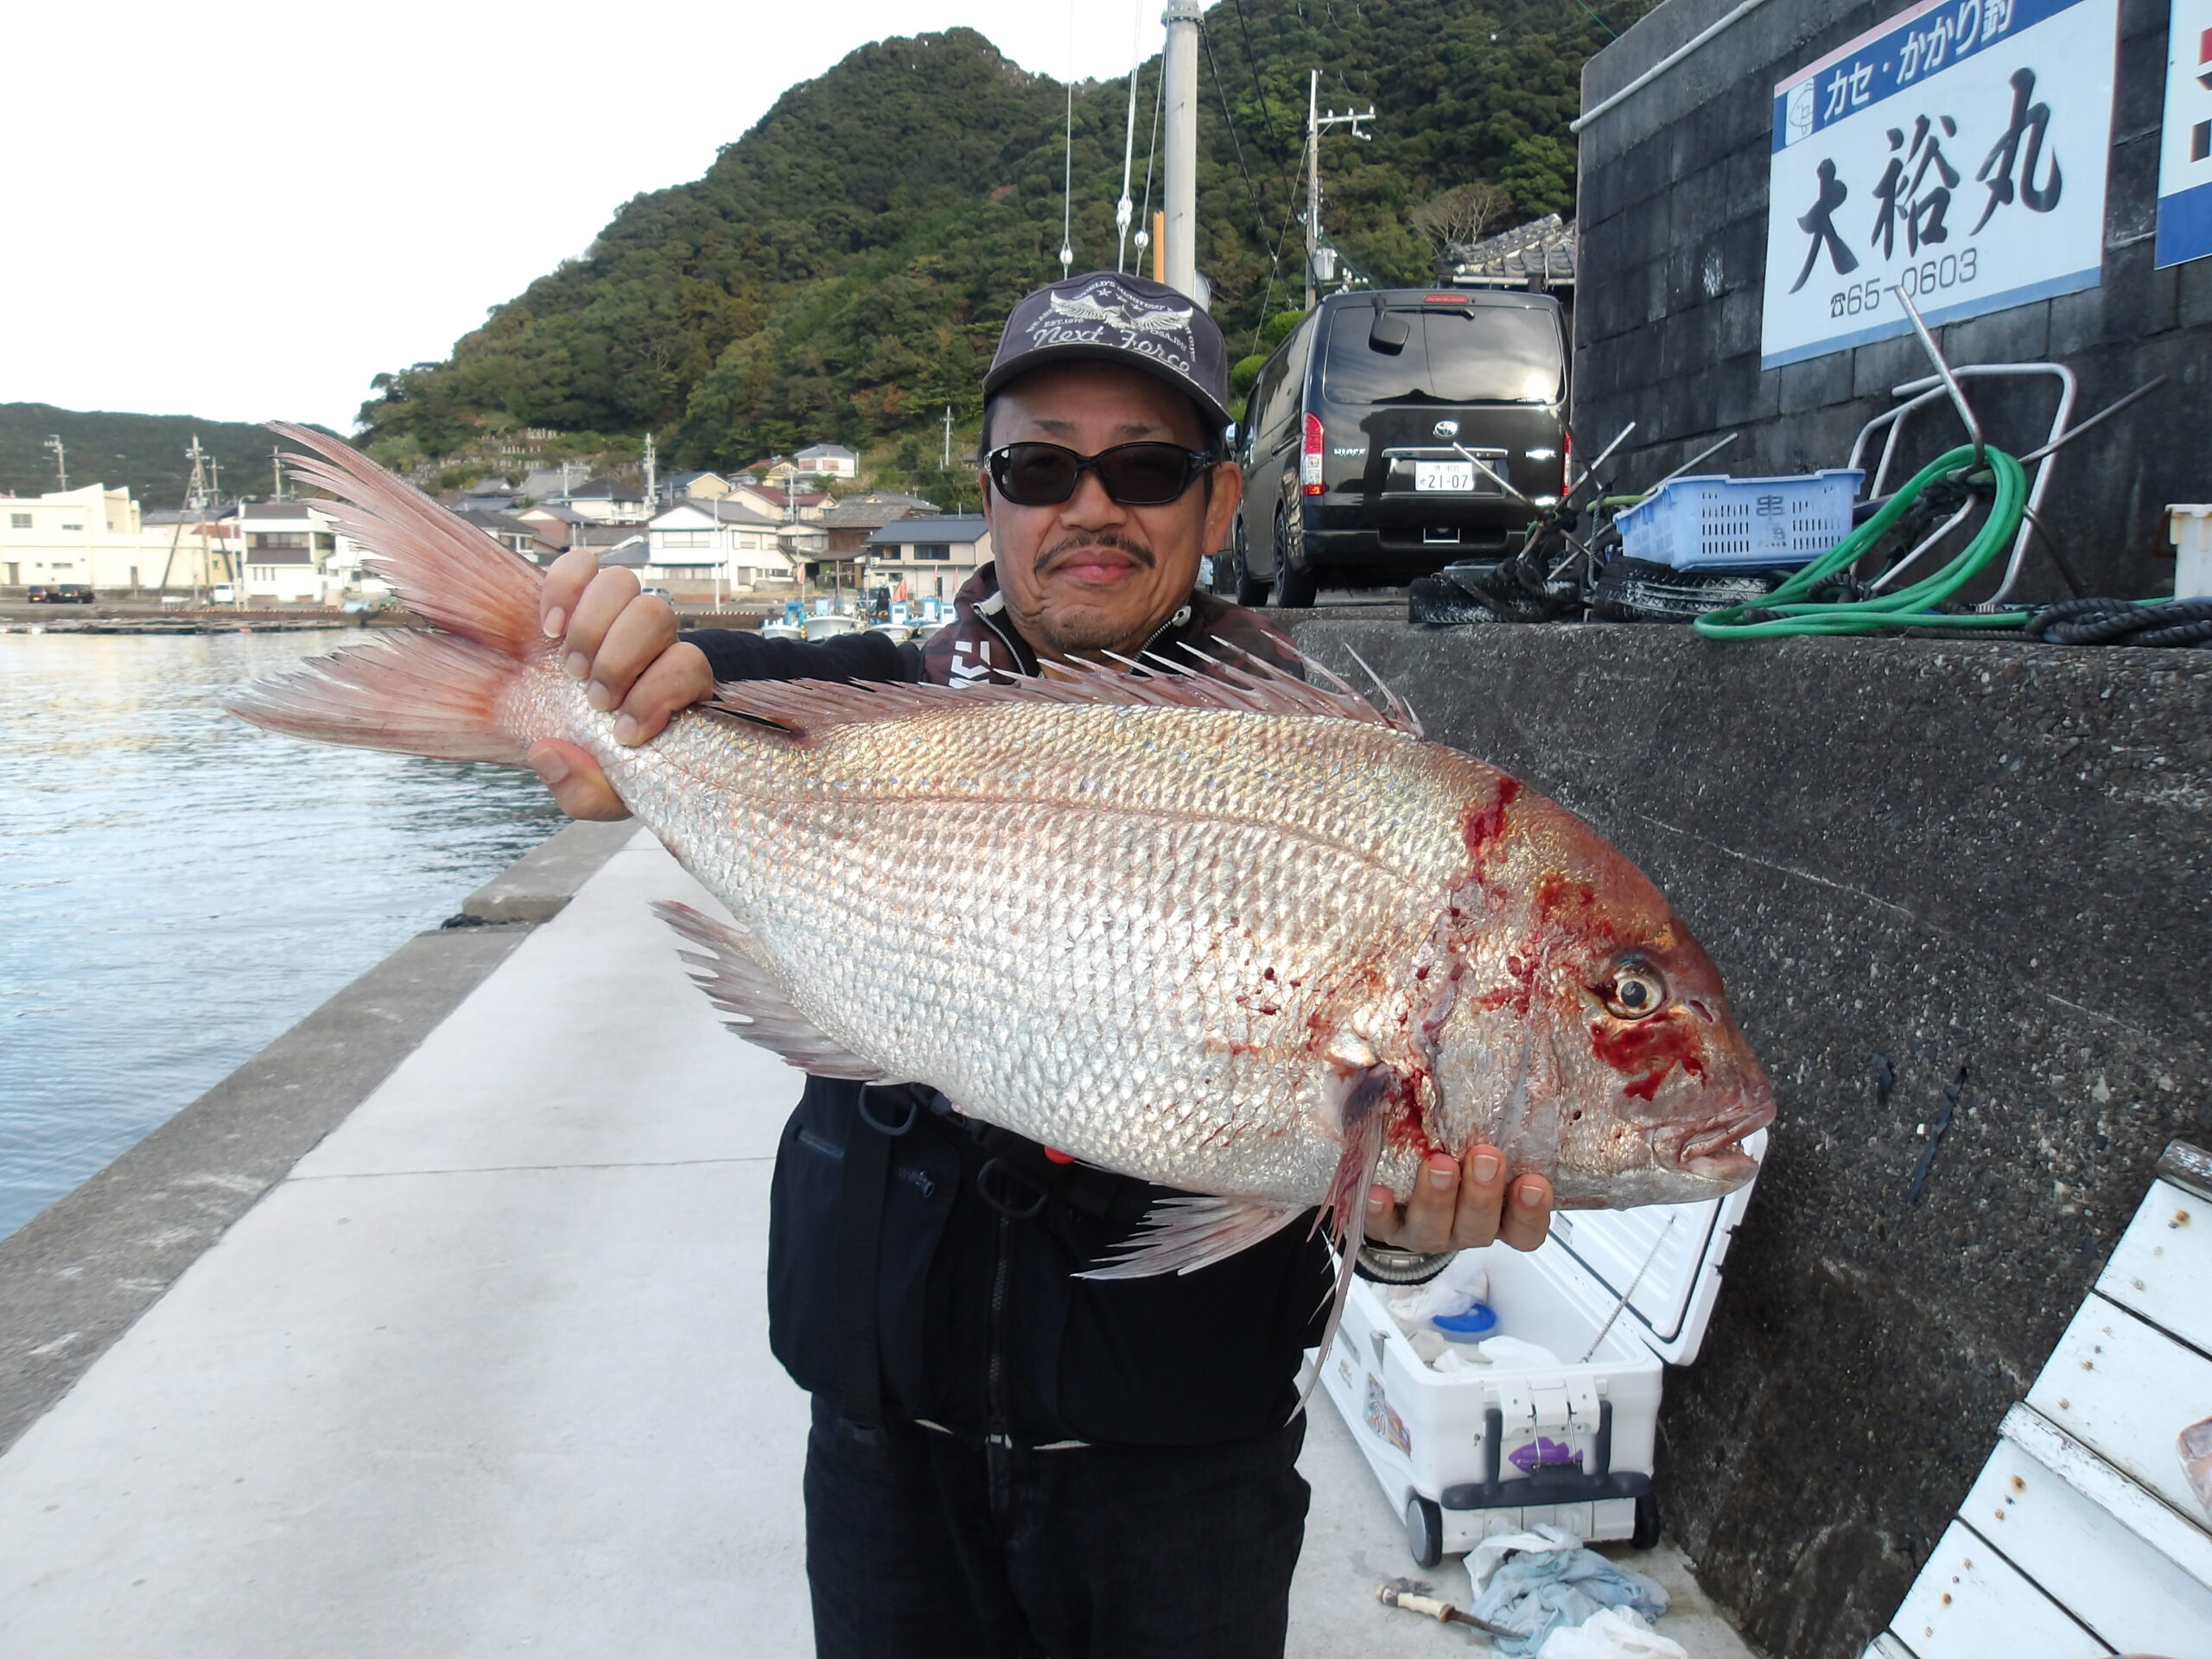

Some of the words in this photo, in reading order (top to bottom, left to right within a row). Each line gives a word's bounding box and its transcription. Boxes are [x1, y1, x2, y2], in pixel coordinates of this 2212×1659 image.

[1789, 67, 2063, 294] 大裕丸
[1033, 325, 1104, 348] Next
[1427, 474, 1469, 489] 21-07
